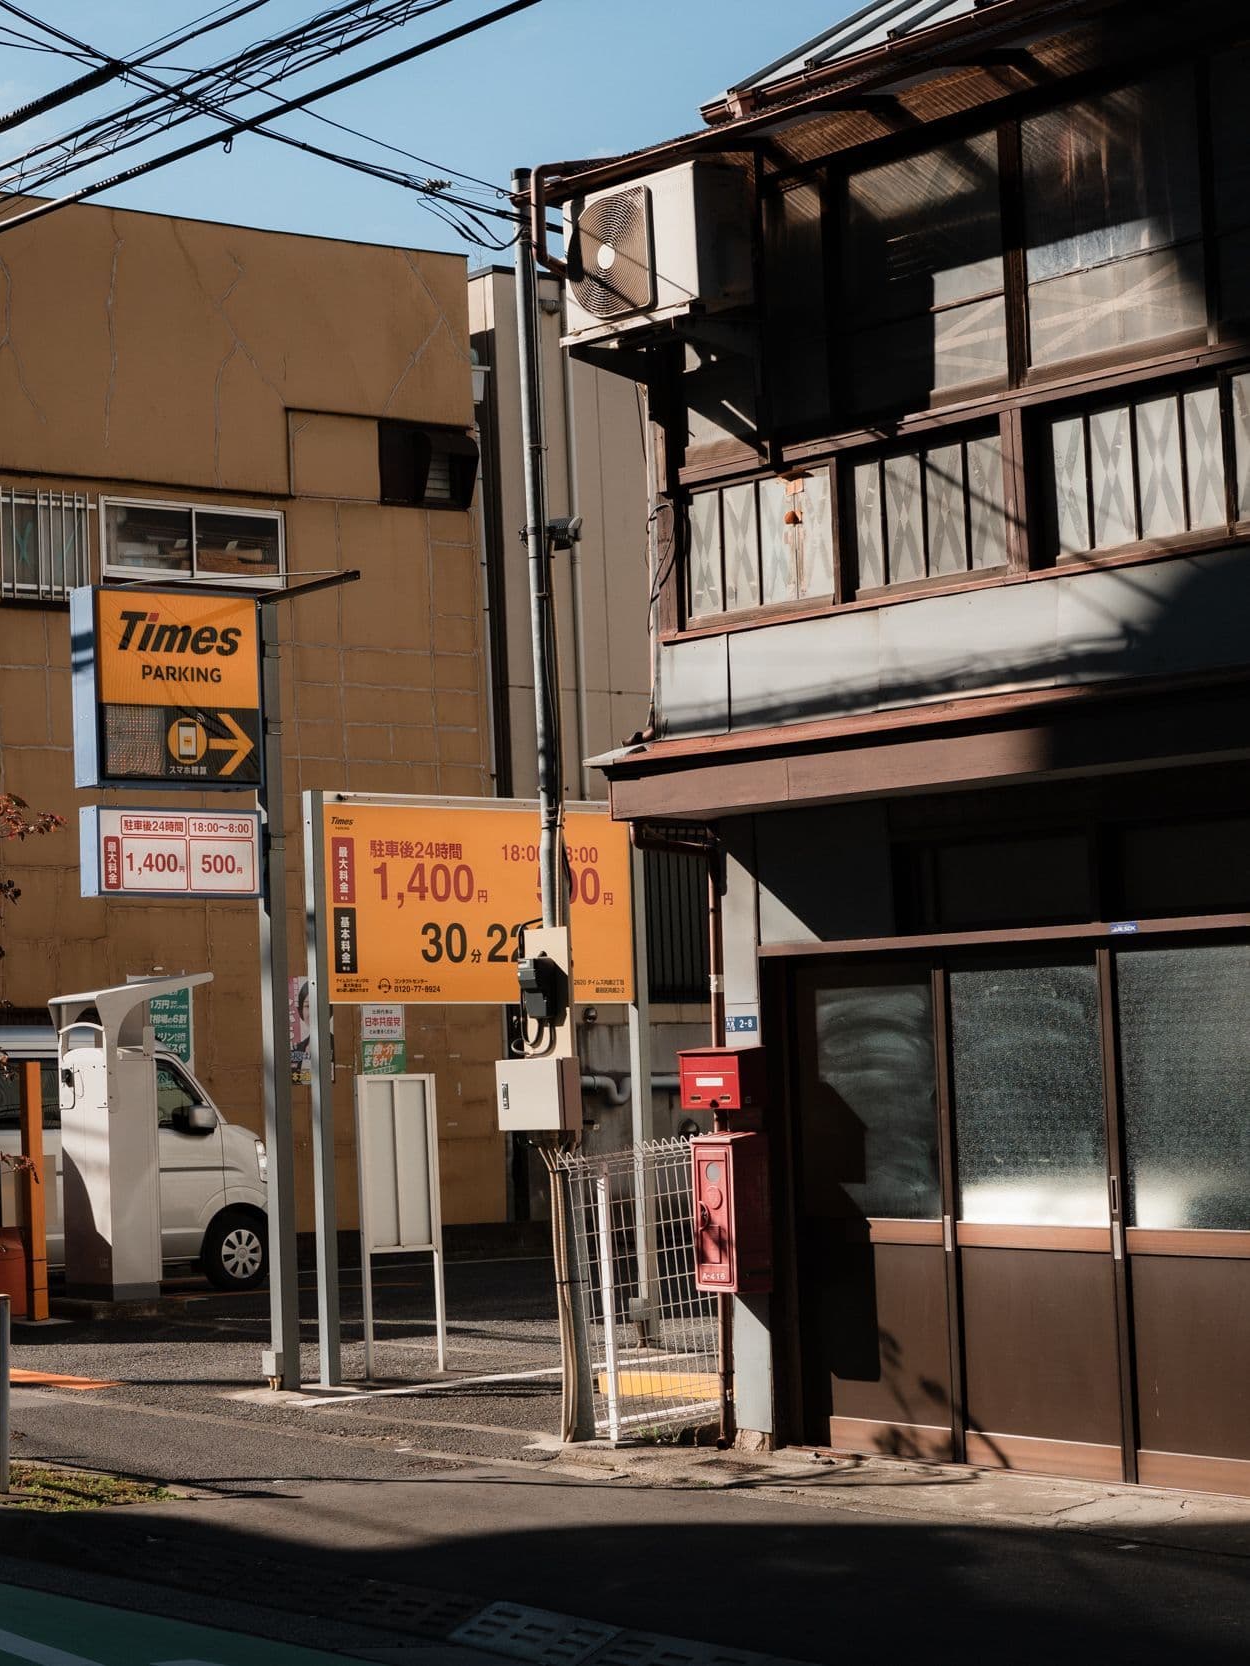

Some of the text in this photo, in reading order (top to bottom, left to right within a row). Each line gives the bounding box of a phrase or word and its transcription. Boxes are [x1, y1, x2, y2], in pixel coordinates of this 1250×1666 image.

[118, 610, 242, 656] Times
[141, 664, 222, 683] PARKING
[123, 819, 184, 833] 駐車後24時間
[331, 816, 354, 826] Times
[369, 839, 463, 860] 駐車後24時間
[107, 842, 117, 884] 最大料金
[338, 846, 349, 893] 最大料金
[340, 916, 351, 964] 基本料金
[394, 985, 441, 993] 0120-77-8924
[365, 1017, 401, 1027] 日本共産党
[739, 1018, 753, 1029] 2-8
